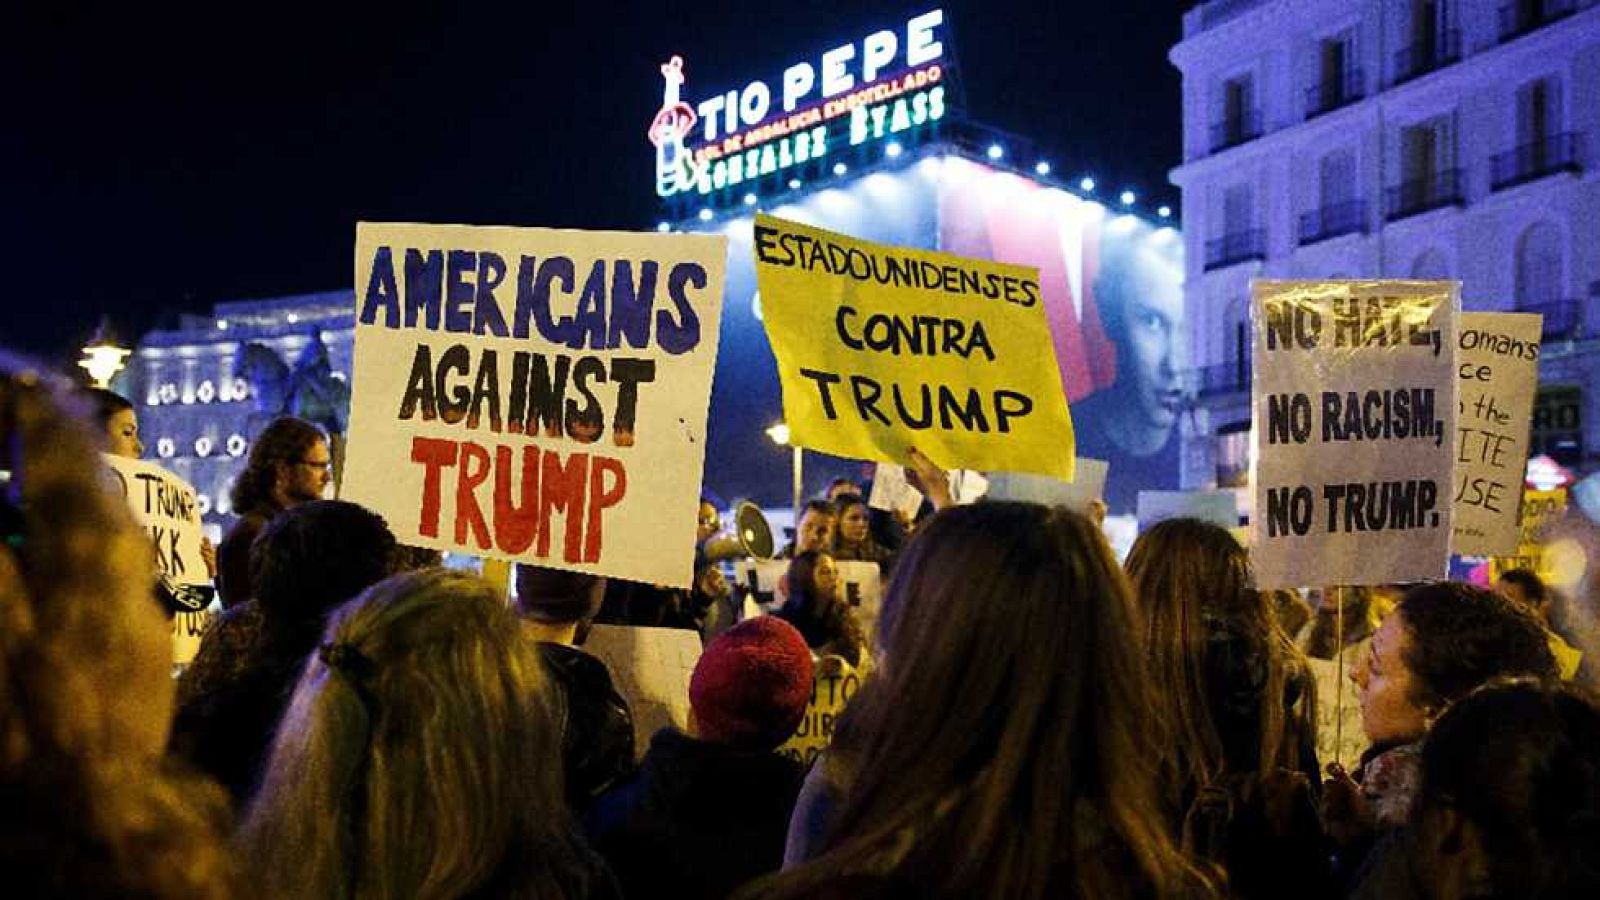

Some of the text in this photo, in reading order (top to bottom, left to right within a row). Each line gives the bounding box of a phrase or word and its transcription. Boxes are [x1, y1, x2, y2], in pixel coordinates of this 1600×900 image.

[697, 8, 943, 140] TIO PEPE
[849, 87, 944, 145] BYASS
[754, 226, 1039, 307] ESTADOUNIDENSES
[359, 246, 707, 354] AMERICANS
[1266, 296, 1442, 357] NO HATE,
[836, 305, 997, 361] CONTRA
[1459, 330, 1540, 361] oman's
[398, 344, 656, 446] AGAINST
[800, 368, 1033, 434] TRUMP
[1267, 388, 1443, 449] NO RACISM,
[1475, 396, 1510, 426] the
[1459, 428, 1515, 468] ITE
[410, 436, 627, 564] TRUMP
[1267, 480, 1438, 537] NO TRUMP.
[152, 525, 186, 576] KK
